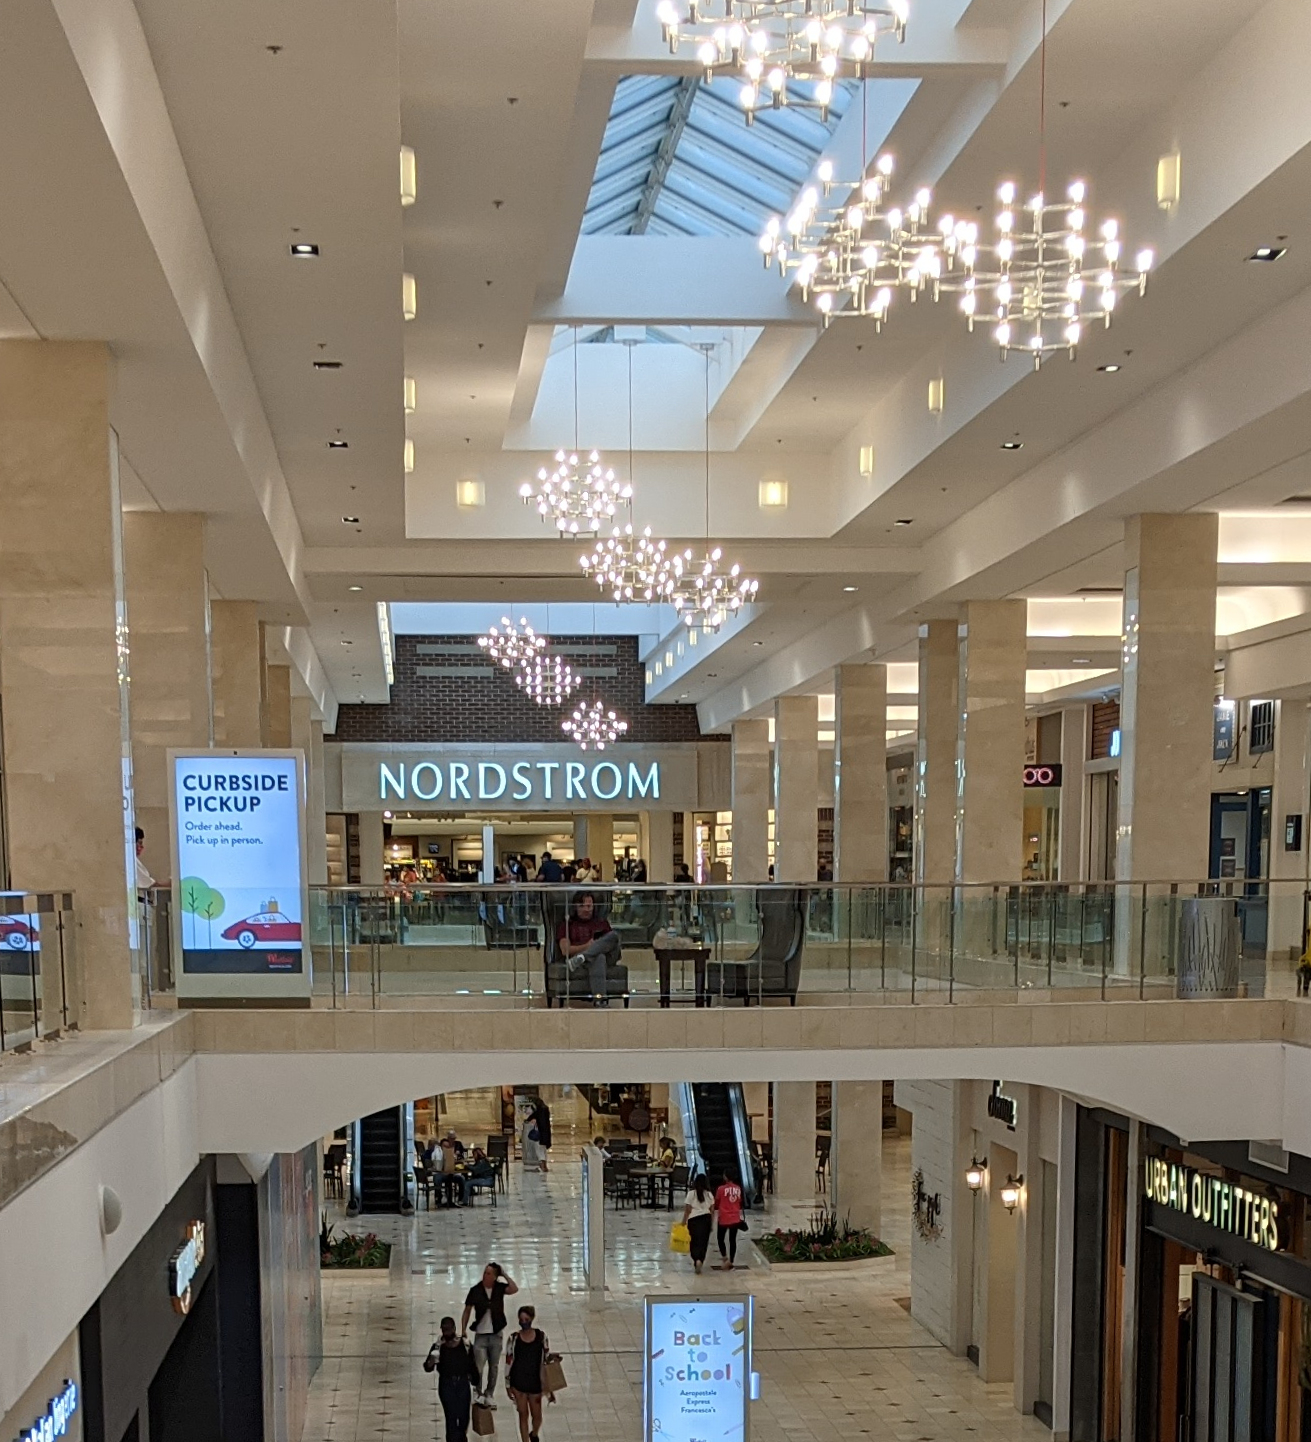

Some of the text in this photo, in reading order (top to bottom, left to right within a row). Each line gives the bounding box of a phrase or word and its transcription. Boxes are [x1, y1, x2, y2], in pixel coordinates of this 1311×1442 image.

[183, 774, 289, 791] CURBSIDE
[380, 761, 659, 800] NORDSTROM
[184, 796, 261, 812] PICKUP
[185, 821, 243, 831] Order ahead.
[186, 834, 264, 847] Pick up in person.
[1145, 1155, 1279, 1251] URBAN OUTFITTERS
[673, 1330, 721, 1346] Back
[688, 1348, 708, 1362] to
[665, 1363, 731, 1381] School
